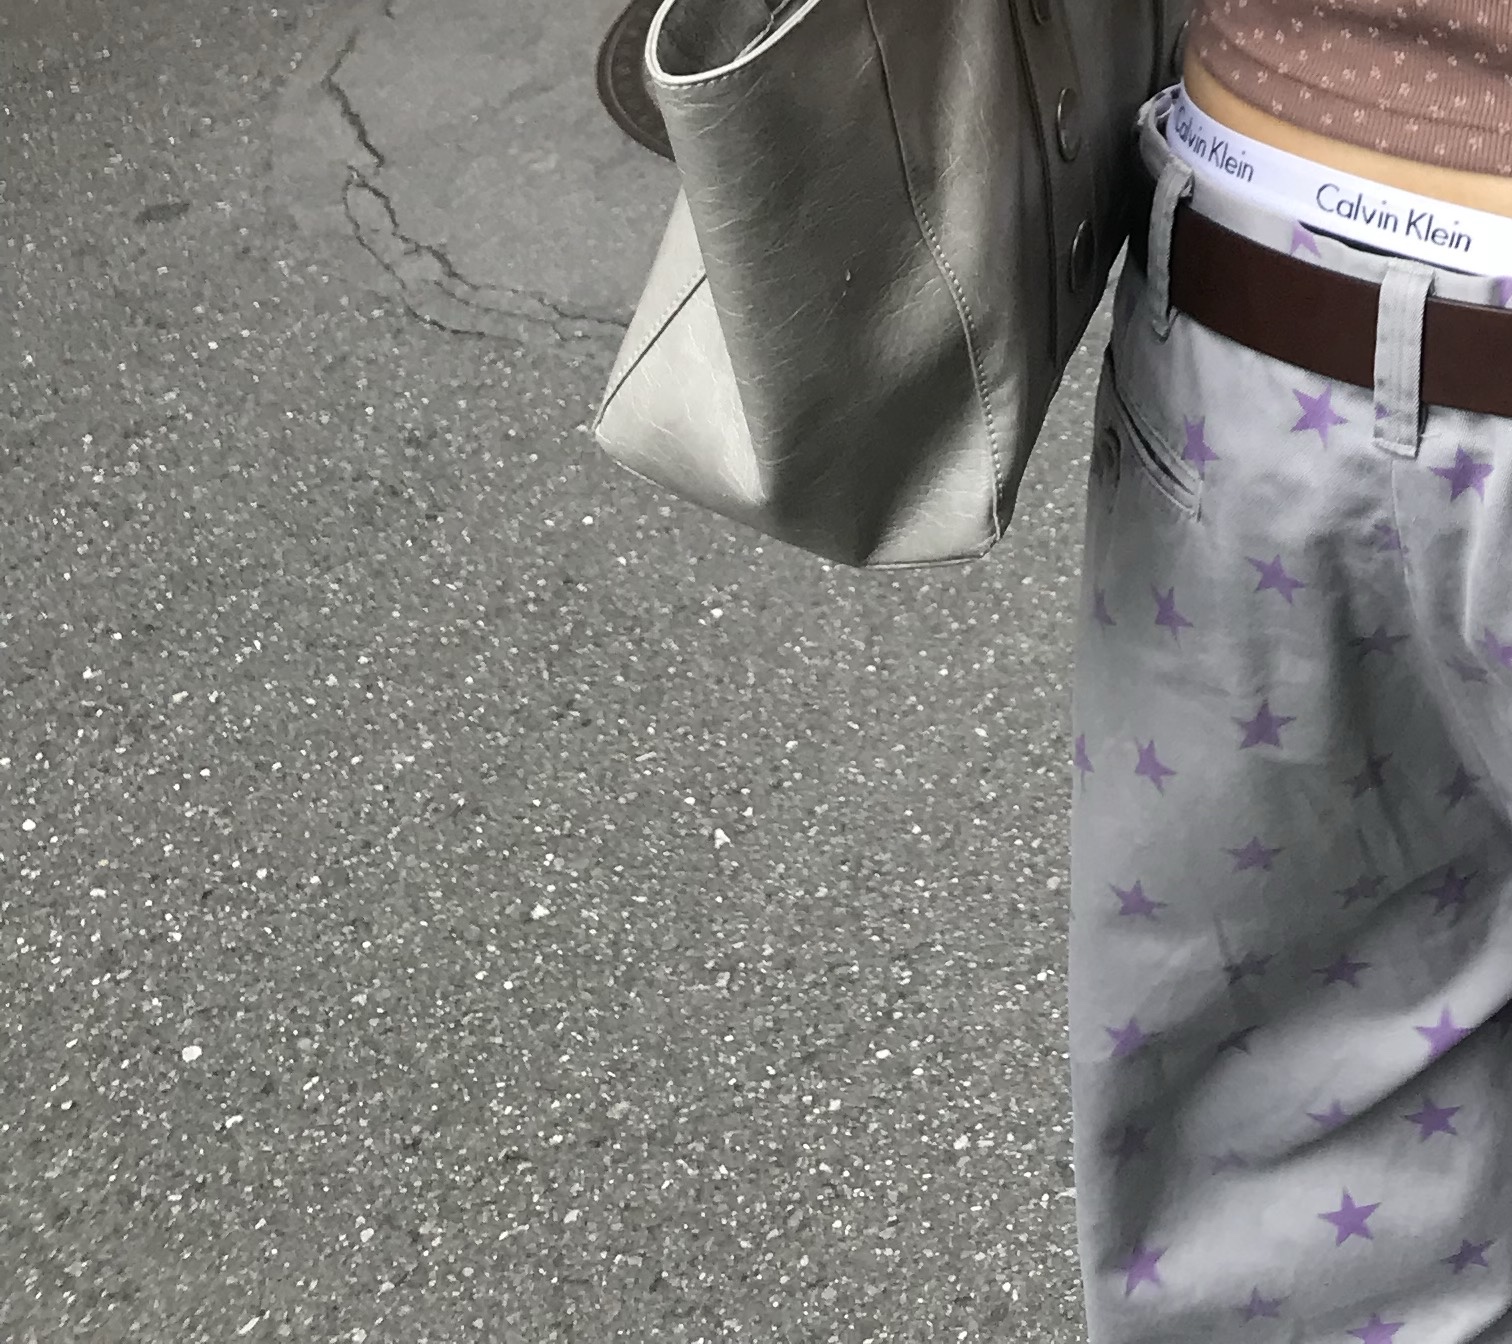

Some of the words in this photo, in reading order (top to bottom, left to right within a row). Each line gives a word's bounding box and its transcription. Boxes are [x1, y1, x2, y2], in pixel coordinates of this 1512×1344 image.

[1175, 105, 1207, 158] Calvin
[1208, 136, 1255, 183] Klein
[1315, 182, 1399, 236] Calvin
[1404, 209, 1473, 254] Klein
